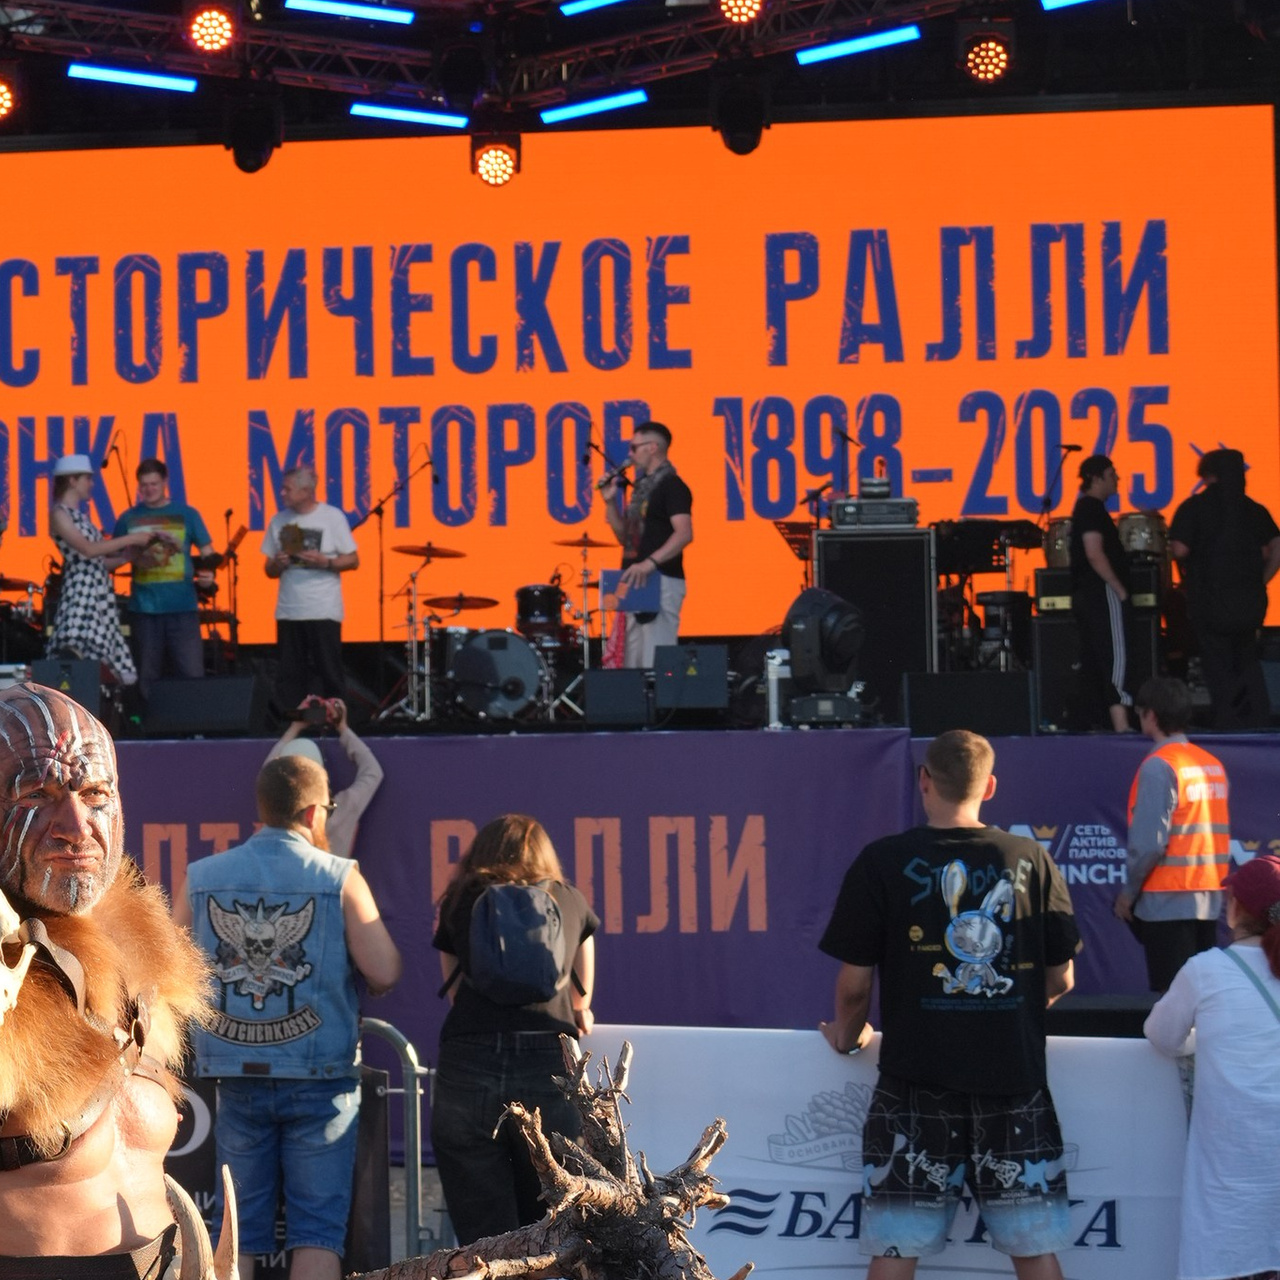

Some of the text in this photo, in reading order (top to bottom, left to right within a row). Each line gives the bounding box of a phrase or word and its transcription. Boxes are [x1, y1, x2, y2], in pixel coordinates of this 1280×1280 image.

[764, 219, 1170, 367] РАЛЛИ
[1075, 824, 1111, 836] СЕТЬ
[1070, 836, 1117, 847] АКТИВ
[1068, 848, 1128, 860] ПАРКОВ
[430, 814, 767, 935] РЛЛИ
[1056, 863, 1127, 885] INCH
[209, 1009, 318, 1044] VOCHERKASSK
[787, 1137, 856, 1159] ОСНОВАНА
